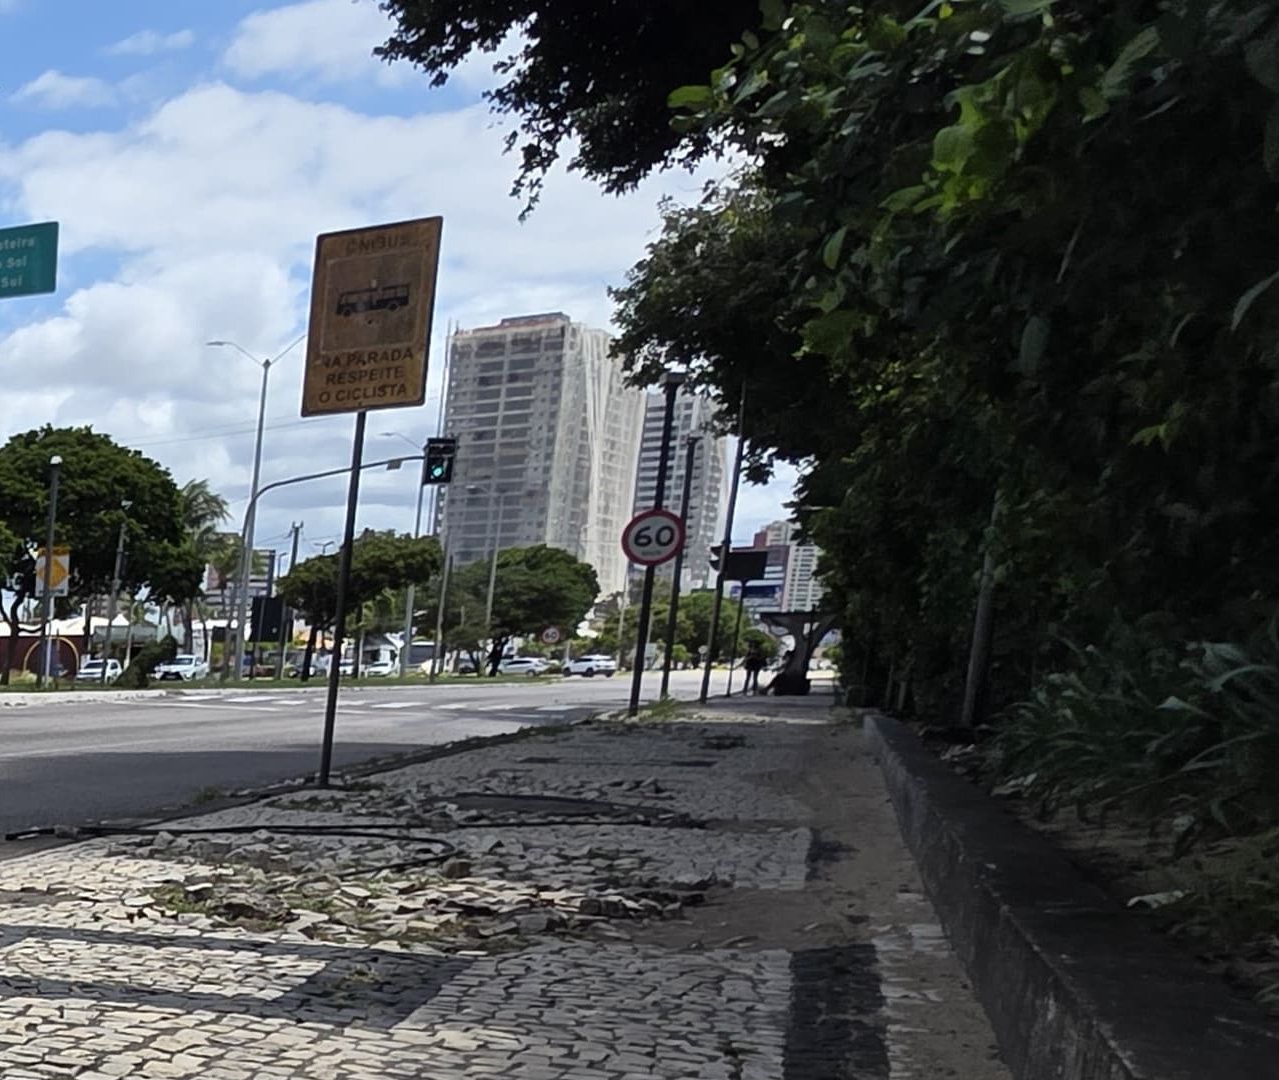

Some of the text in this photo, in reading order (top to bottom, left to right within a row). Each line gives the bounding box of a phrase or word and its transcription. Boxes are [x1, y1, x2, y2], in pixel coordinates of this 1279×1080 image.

[7, 256, 27, 268] Sol
[1, 275, 23, 288] Sul
[347, 347, 413, 366] PARADA
[325, 366, 404, 385] RESPEITE
[319, 383, 407, 403] O CICLISTA
[634, 525, 675, 547] 60
